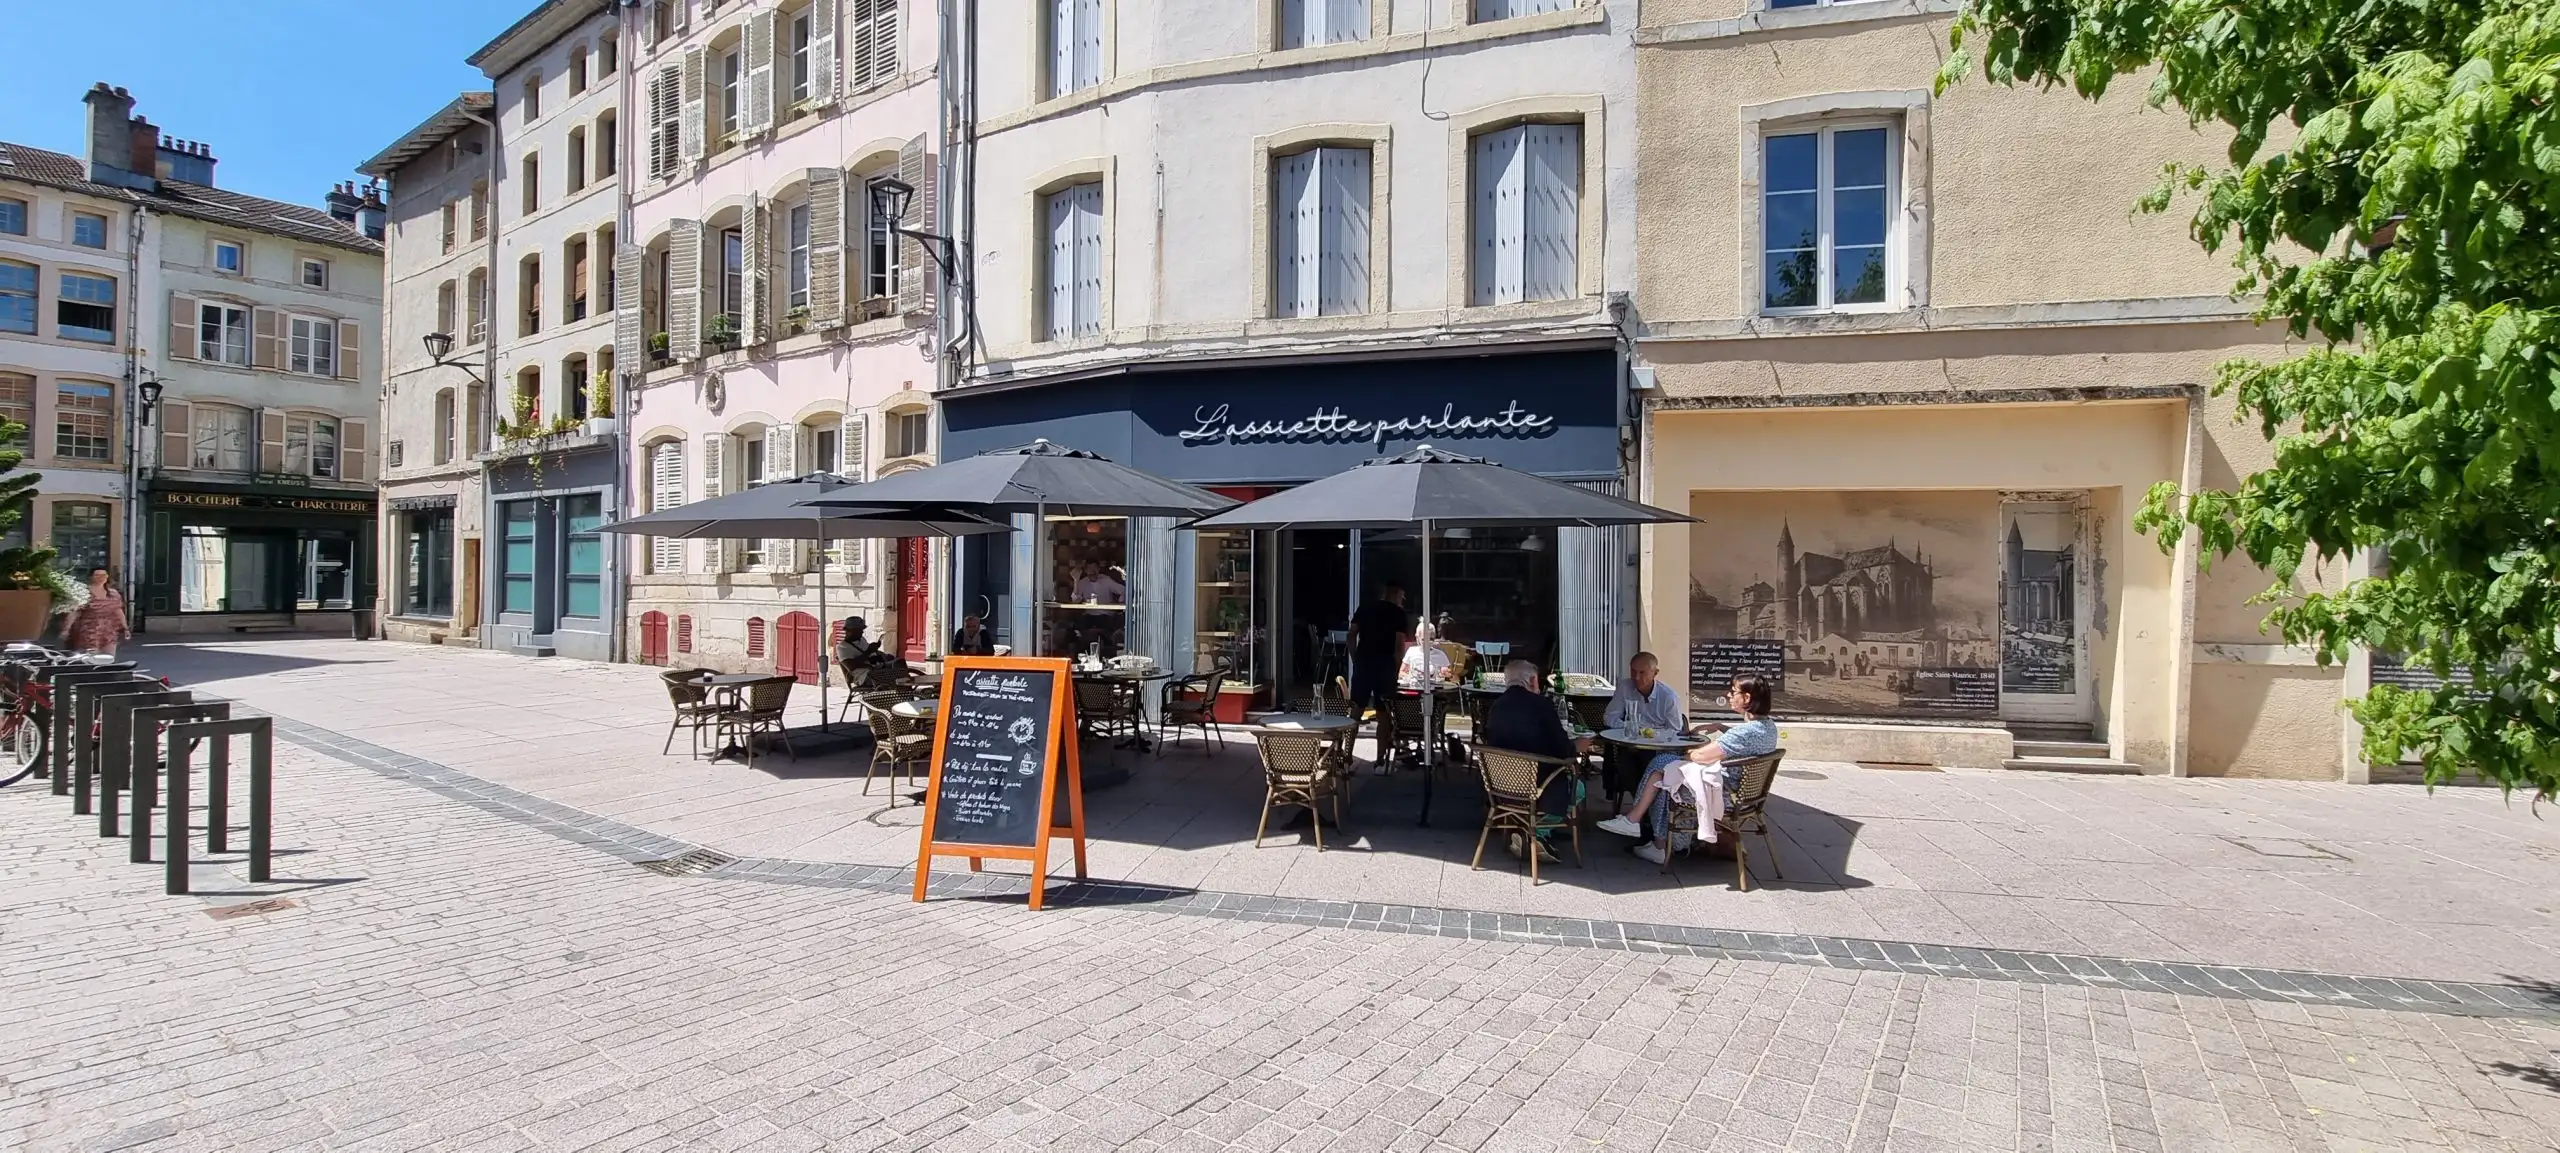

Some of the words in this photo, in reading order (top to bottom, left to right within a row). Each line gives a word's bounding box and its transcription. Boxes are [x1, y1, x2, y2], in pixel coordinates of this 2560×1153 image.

[1179, 403, 1372, 439] L'assiette
[1373, 400, 1553, 443] parlante
[168, 493, 242, 506] BOUCHERIE
[291, 500, 368, 513] CHARCUTERIE
[1916, 671, 1934, 679] Église
[1935, 671, 1978, 679] Saint-Maurice,
